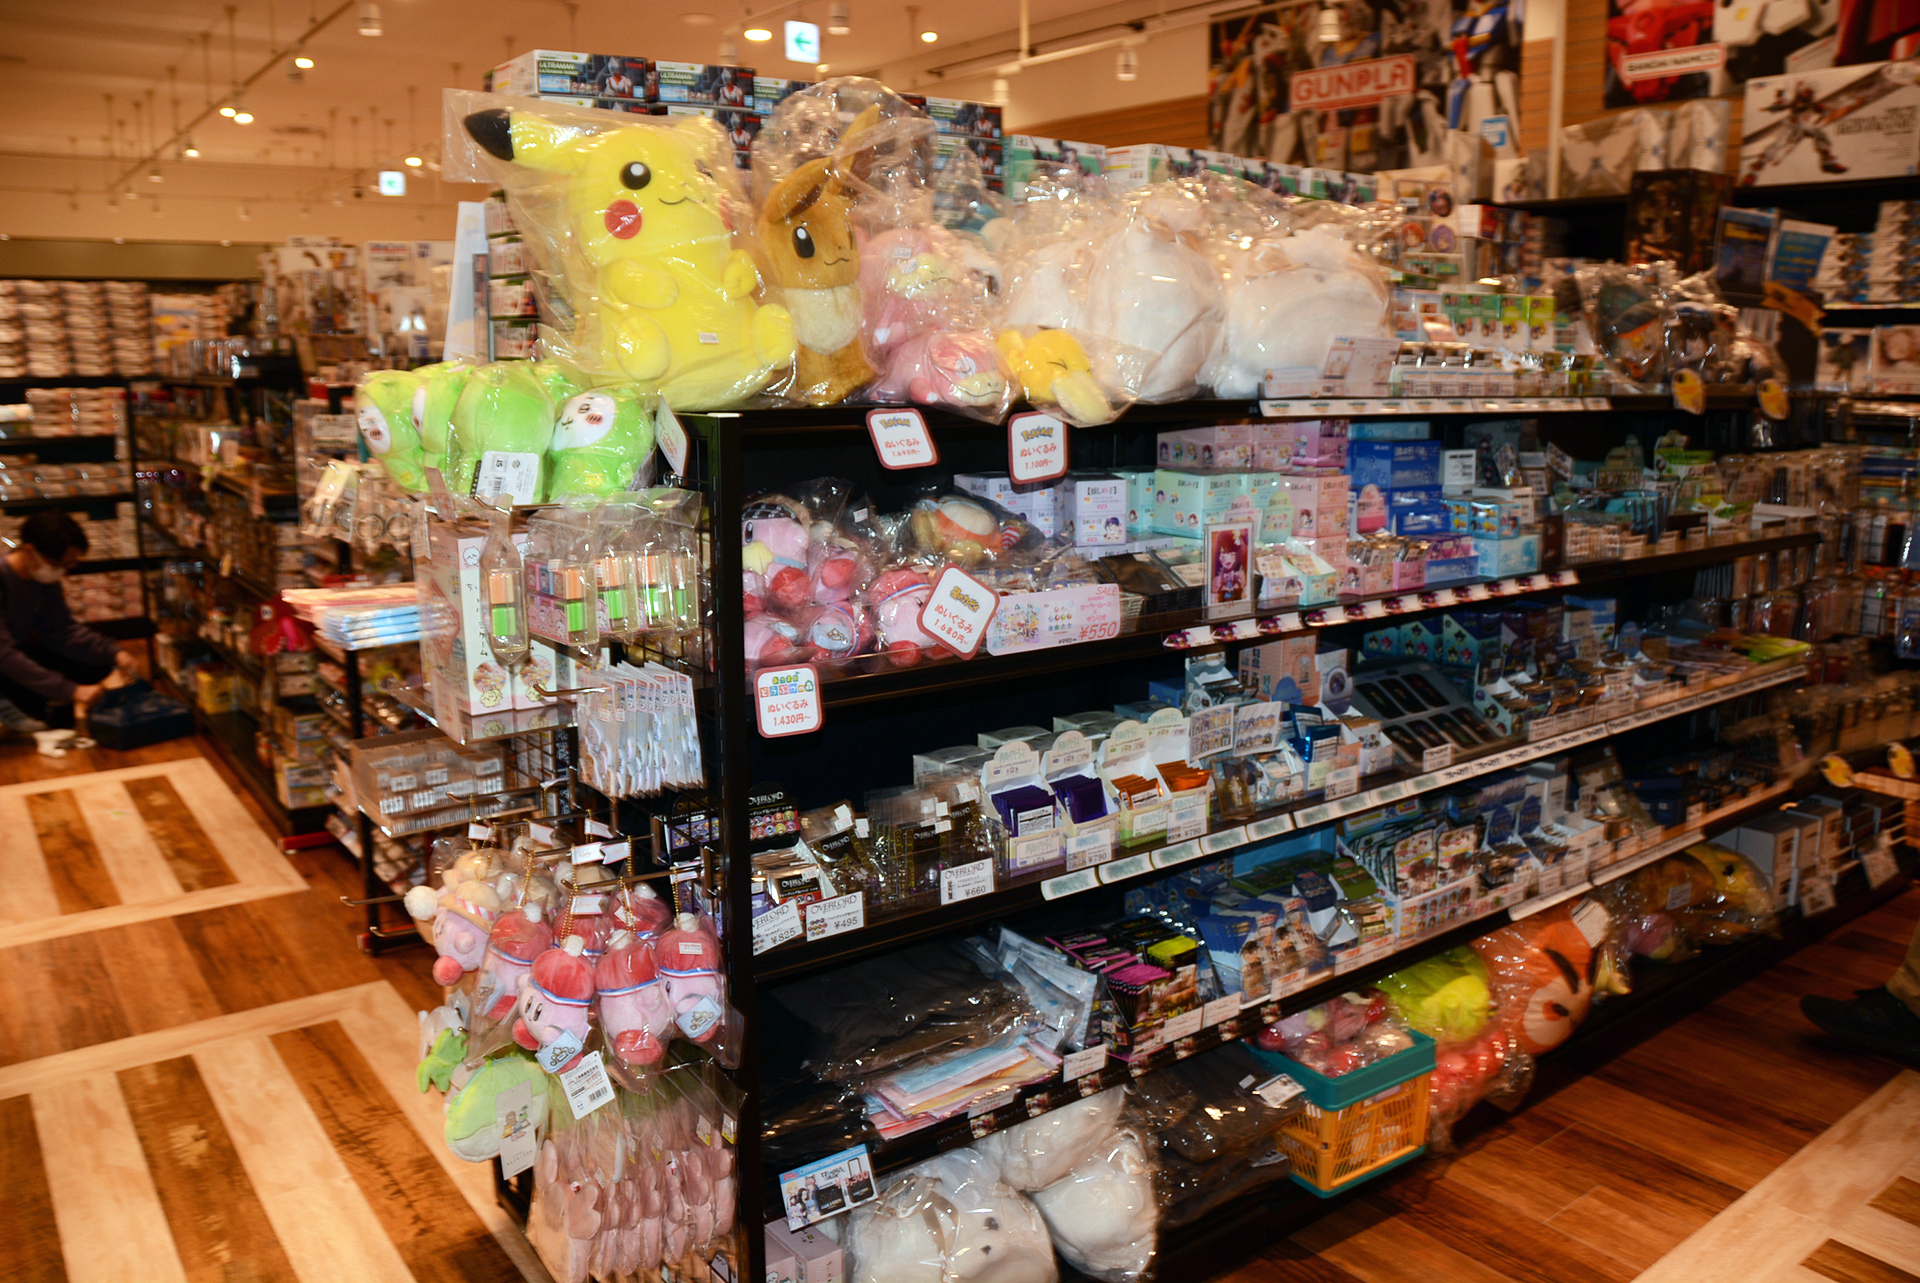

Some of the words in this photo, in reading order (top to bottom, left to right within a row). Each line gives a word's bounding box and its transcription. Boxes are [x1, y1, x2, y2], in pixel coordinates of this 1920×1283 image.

[539, 61, 574, 70] ULTRAMAN
[660, 72, 692, 80] ULTRAMAN
[1295, 62, 1409, 101] GUNPLA
[1020, 425, 1054, 442] Pokémon
[884, 438, 920, 448] ぬいぐるみ
[1020, 442, 1057, 458] ぬいぐるみ
[1096, 586, 1118, 596] SALE
[934, 603, 973, 634] ぬいぐるみ
[1079, 621, 1118, 641] ¥550
[767, 699, 809, 713] ぬいぐるみ
[1088, 853, 1107, 863] ¥790
[944, 861, 985, 879] OVERLORD
[965, 885, 986, 898] ¥660
[810, 894, 857, 914] OVERLORD
[834, 916, 858, 929] ¥495
[771, 927, 796, 945] ¥825
